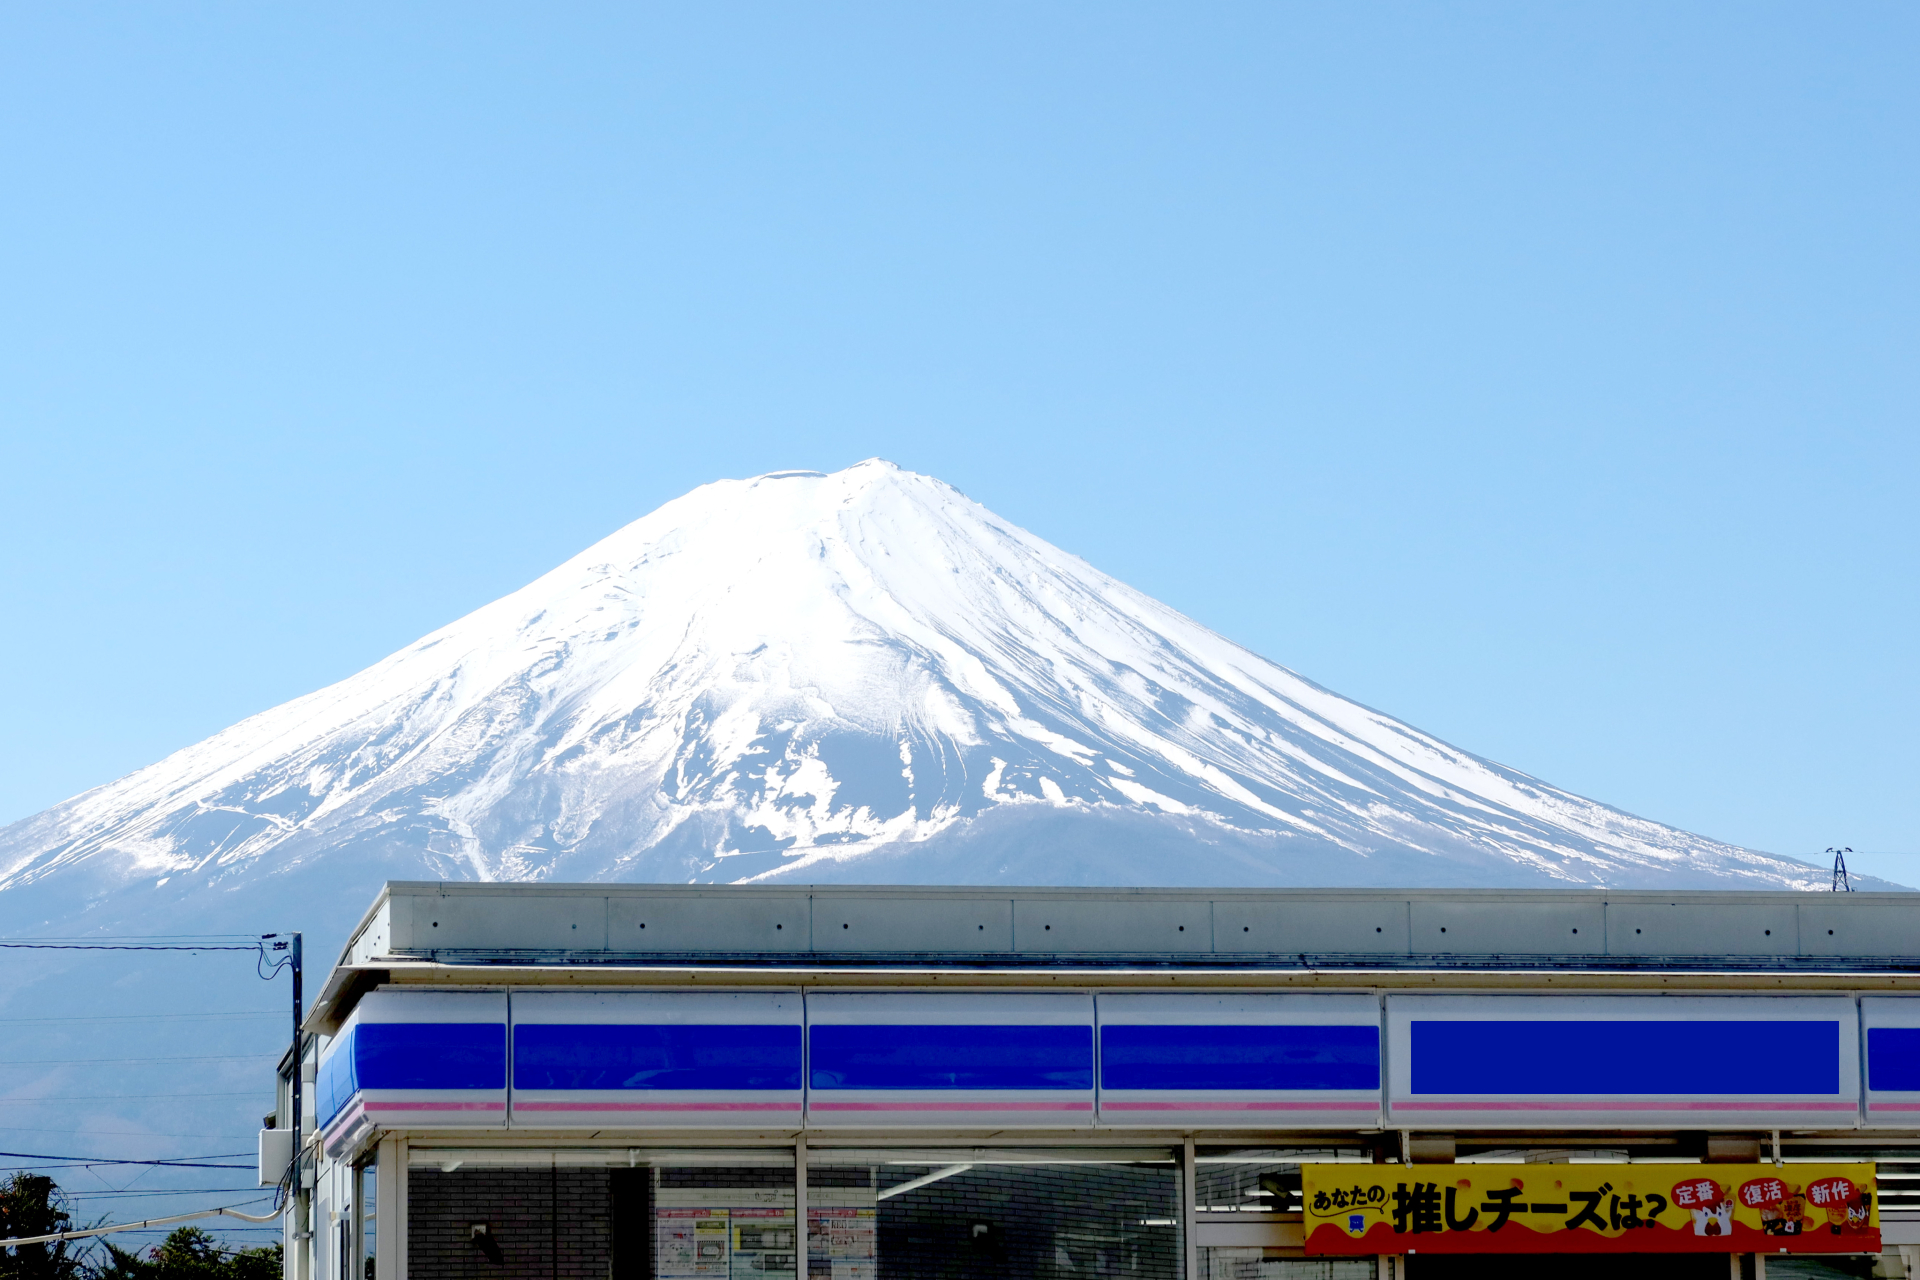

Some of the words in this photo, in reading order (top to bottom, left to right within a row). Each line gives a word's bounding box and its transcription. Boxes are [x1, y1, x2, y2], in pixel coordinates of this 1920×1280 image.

[1675, 1180, 1715, 1206] 定番
[1743, 1179, 1782, 1205] 復活
[1811, 1180, 1850, 1205] 新作
[1313, 1185, 1385, 1211] あなたの
[1392, 1182, 1667, 1234] 推しチーズは?
